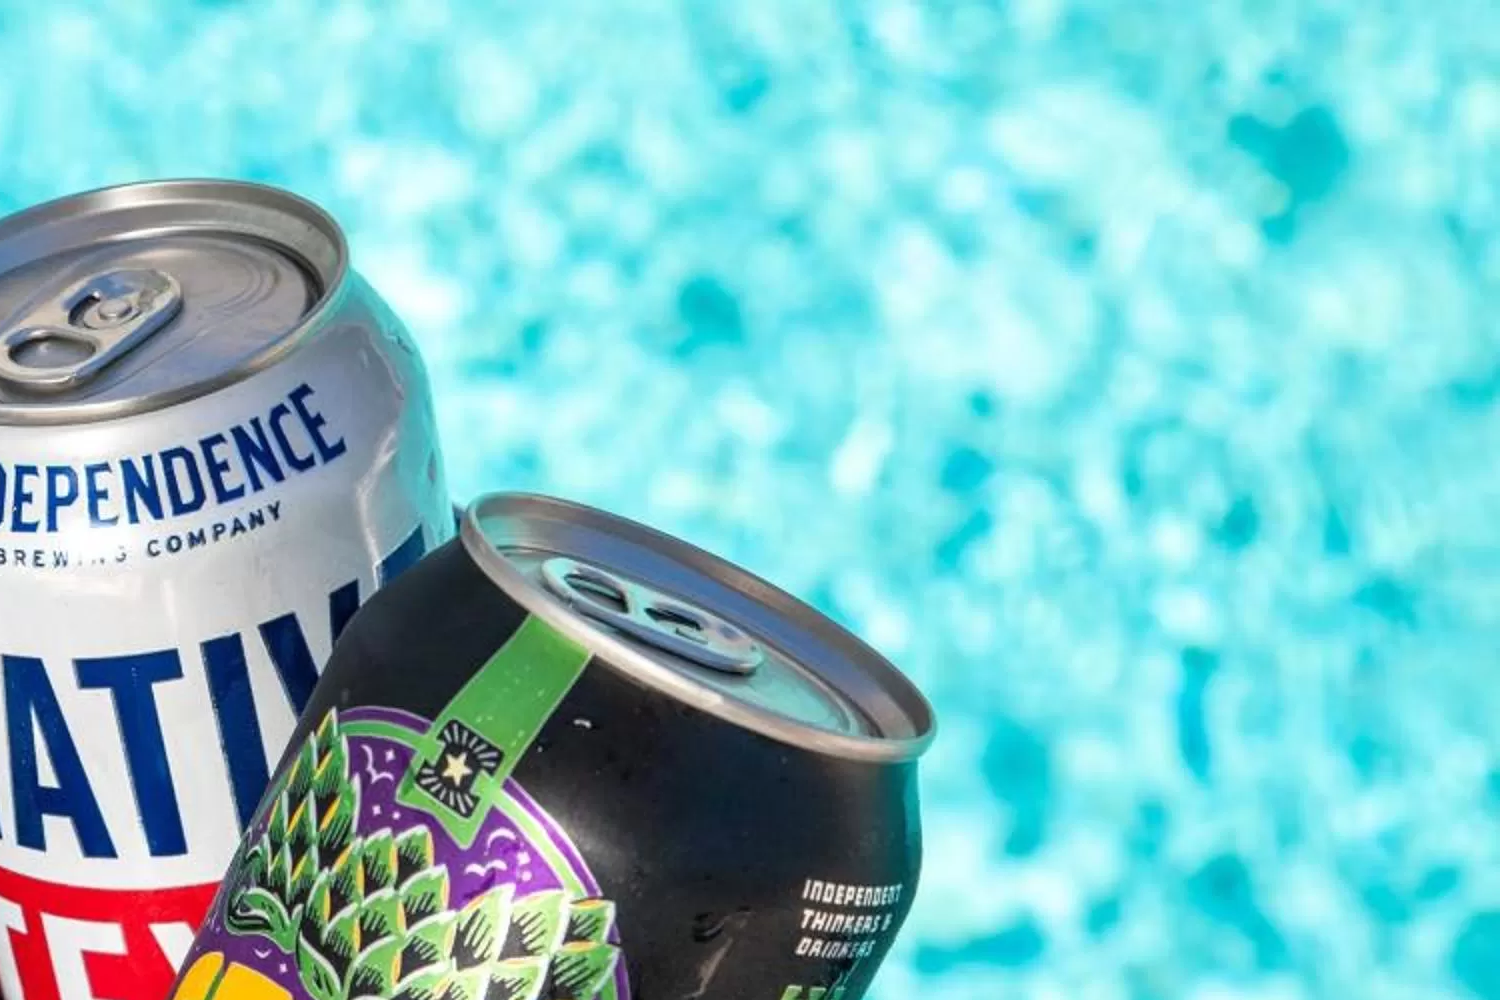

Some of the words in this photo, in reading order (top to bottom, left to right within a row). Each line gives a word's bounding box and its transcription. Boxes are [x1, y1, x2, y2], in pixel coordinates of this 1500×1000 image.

[146, 502, 284, 558] COMPANY
[802, 879, 902, 907] INDEPENDENT
[801, 909, 881, 934] THINKERS
